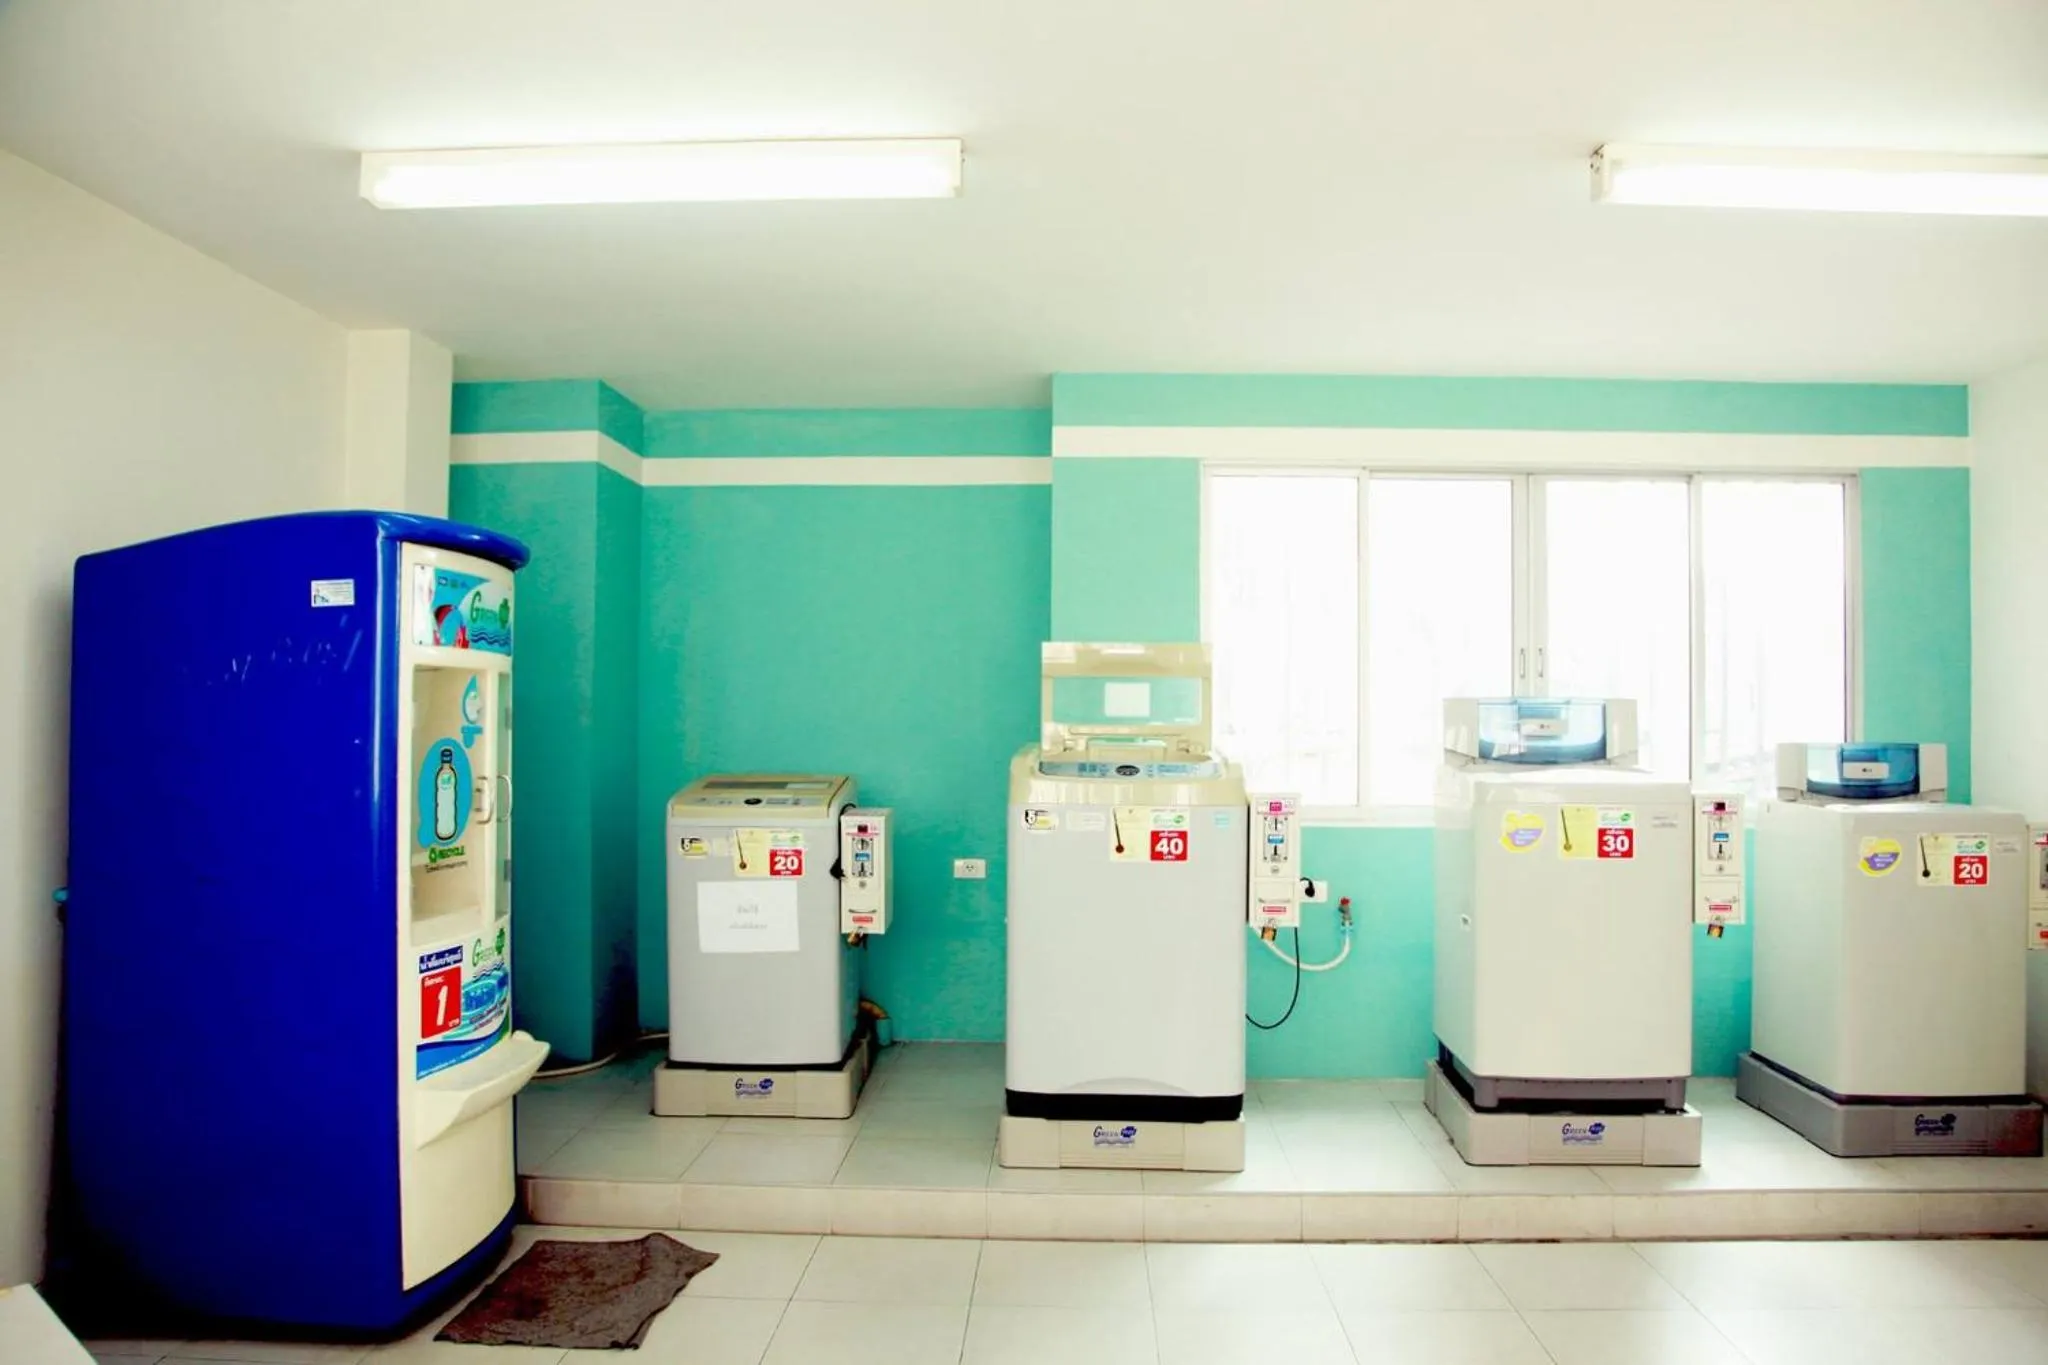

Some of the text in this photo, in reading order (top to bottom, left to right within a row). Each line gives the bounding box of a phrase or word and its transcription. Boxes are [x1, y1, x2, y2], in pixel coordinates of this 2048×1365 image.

[1154, 837, 1184, 856] 40
[1601, 835, 1630, 853] 30
[773, 855, 799, 871] 20
[1958, 863, 1984, 879] 20
[436, 985, 449, 1026] 1
